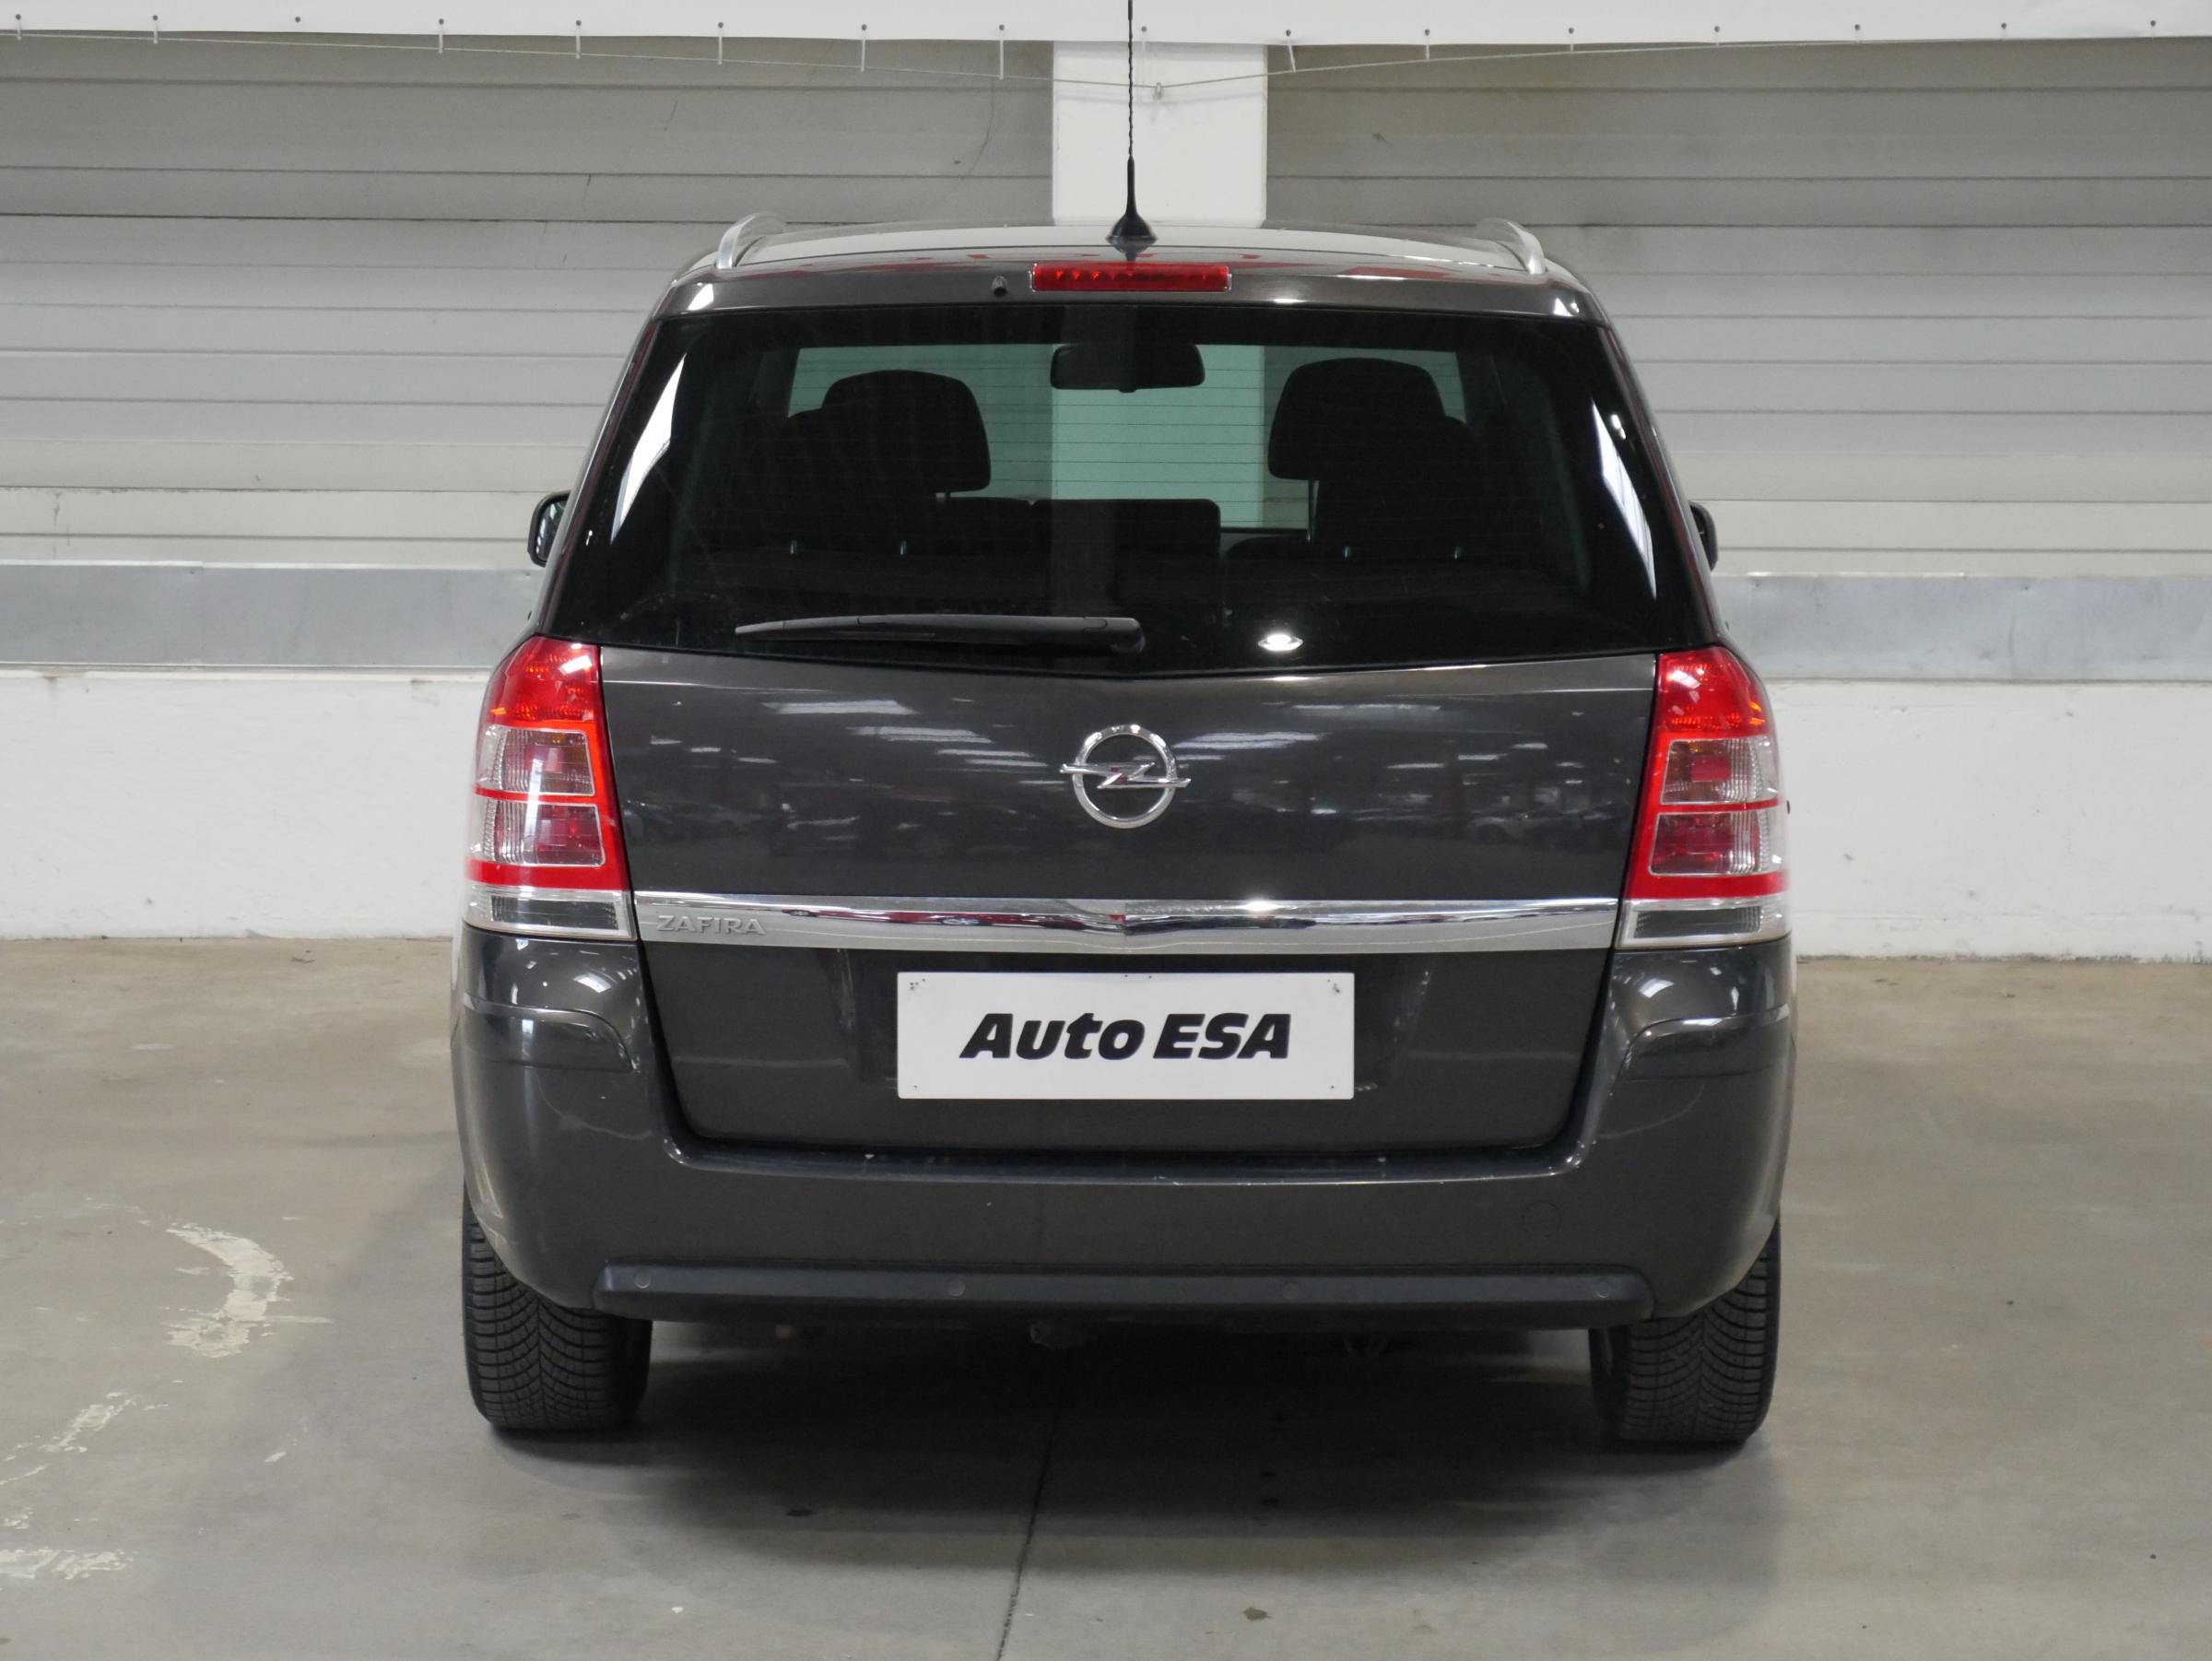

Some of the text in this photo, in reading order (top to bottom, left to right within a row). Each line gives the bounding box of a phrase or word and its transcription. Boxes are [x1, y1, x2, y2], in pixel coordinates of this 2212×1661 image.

[656, 914, 766, 936] ZAFIRA
[959, 1012, 1291, 1060] Auto ESA
